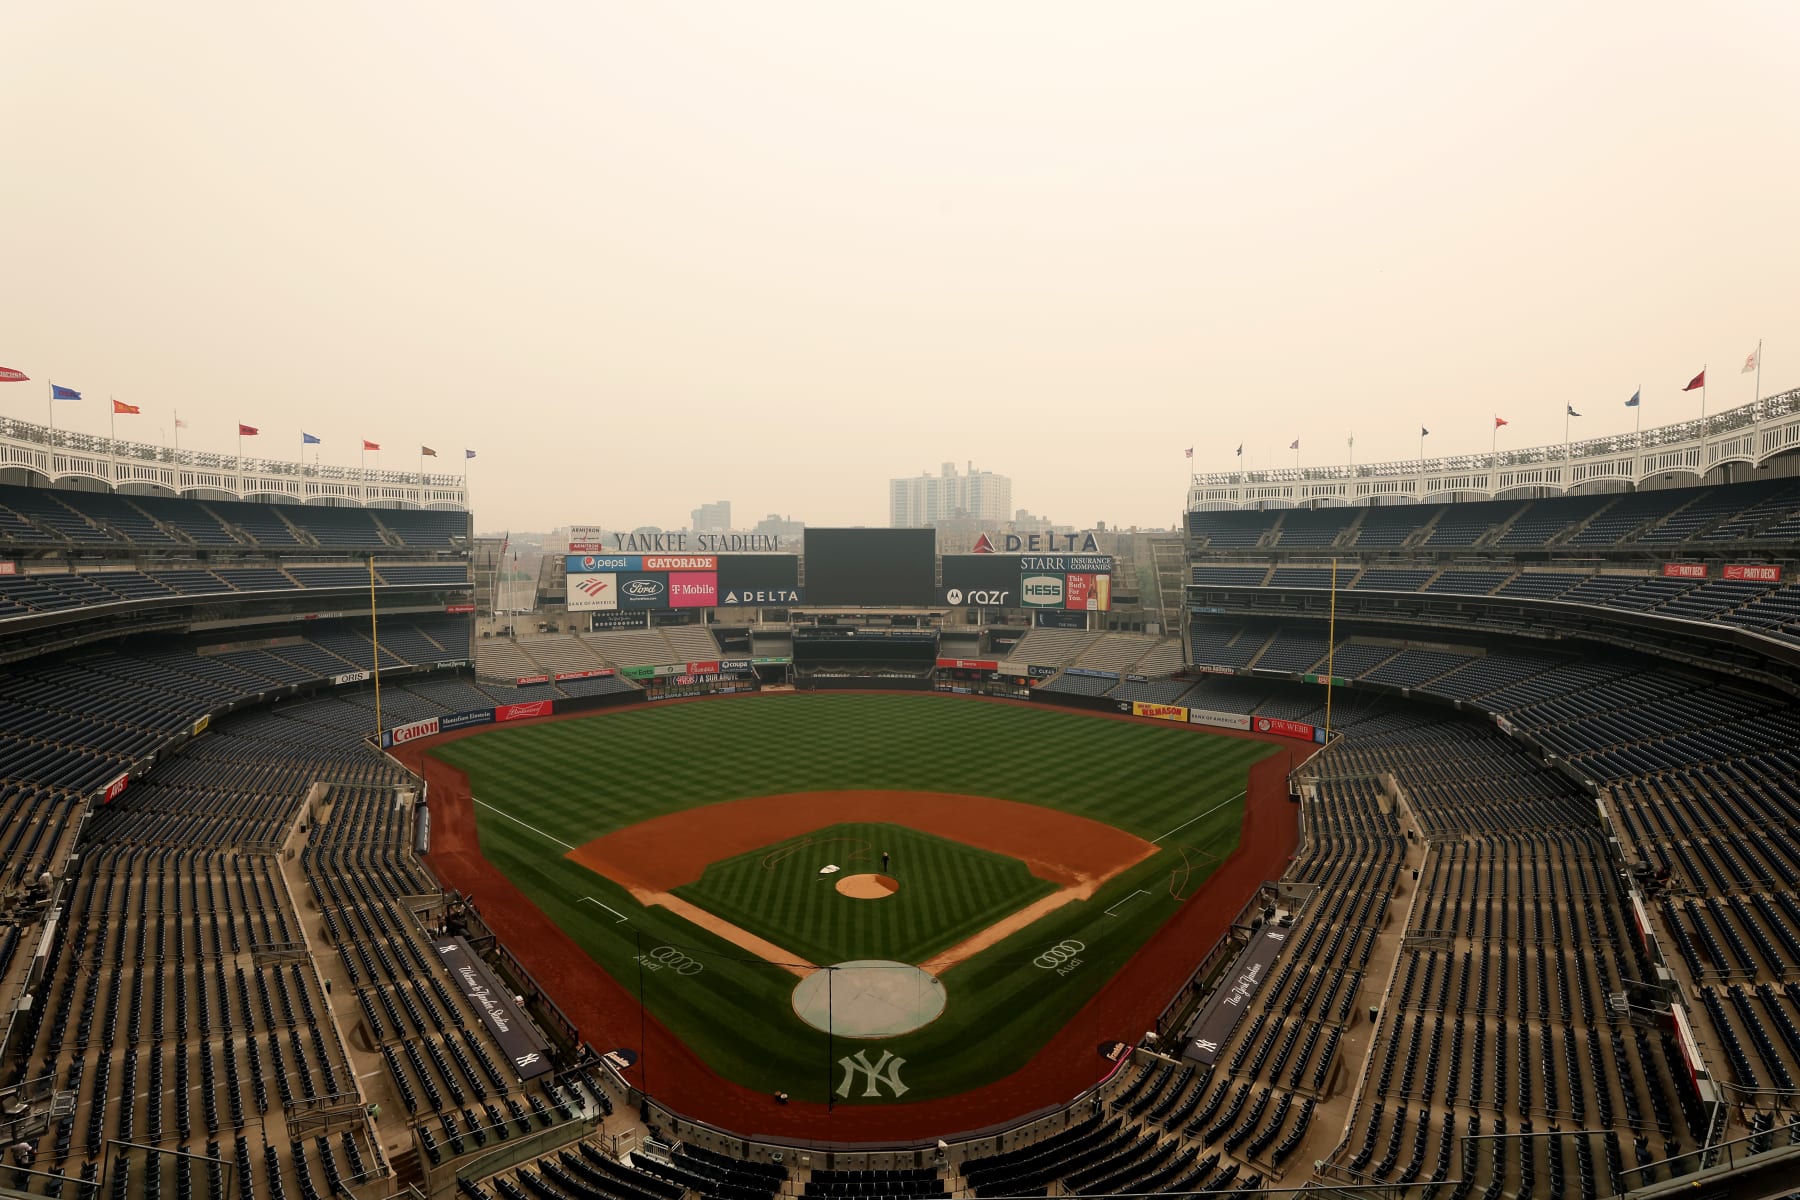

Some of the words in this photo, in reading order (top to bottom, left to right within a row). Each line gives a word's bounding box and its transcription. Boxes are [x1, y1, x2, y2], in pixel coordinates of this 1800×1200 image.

[615, 533, 687, 551] YANKEE
[697, 534, 779, 552] STADIUM
[1006, 532, 1100, 552] DELTA
[597, 557, 626, 569] pepsi
[647, 558, 713, 568] GATORADE
[1021, 557, 1065, 570] STARR
[1679, 566, 1692, 576] PARTY
[1692, 566, 1704, 576] DECK
[1743, 568, 1760, 579] PARTY
[1760, 568, 1776, 579] DECK
[629, 582, 657, 594] Ford
[682, 584, 714, 594] Mobile
[1025, 585, 1061, 596] HESS
[743, 591, 799, 602] DELTA
[967, 590, 1009, 605] razr
[341, 672, 364, 682] ORIS
[1213, 716, 1237, 724] AMERICA
[393, 721, 438, 743] Canon
[1287, 723, 1308, 734] WEBB
[110, 779, 124, 798] AVIS
[632, 954, 664, 972] Audi
[1056, 958, 1085, 977] Audi
[1240, 963, 1262, 985] Yankees
[1232, 980, 1251, 998] York
[458, 966, 478, 988] Welcome
[468, 988, 498, 1012] Yankee
[489, 1009, 510, 1033] Stadium
[1224, 994, 1242, 1007] New
